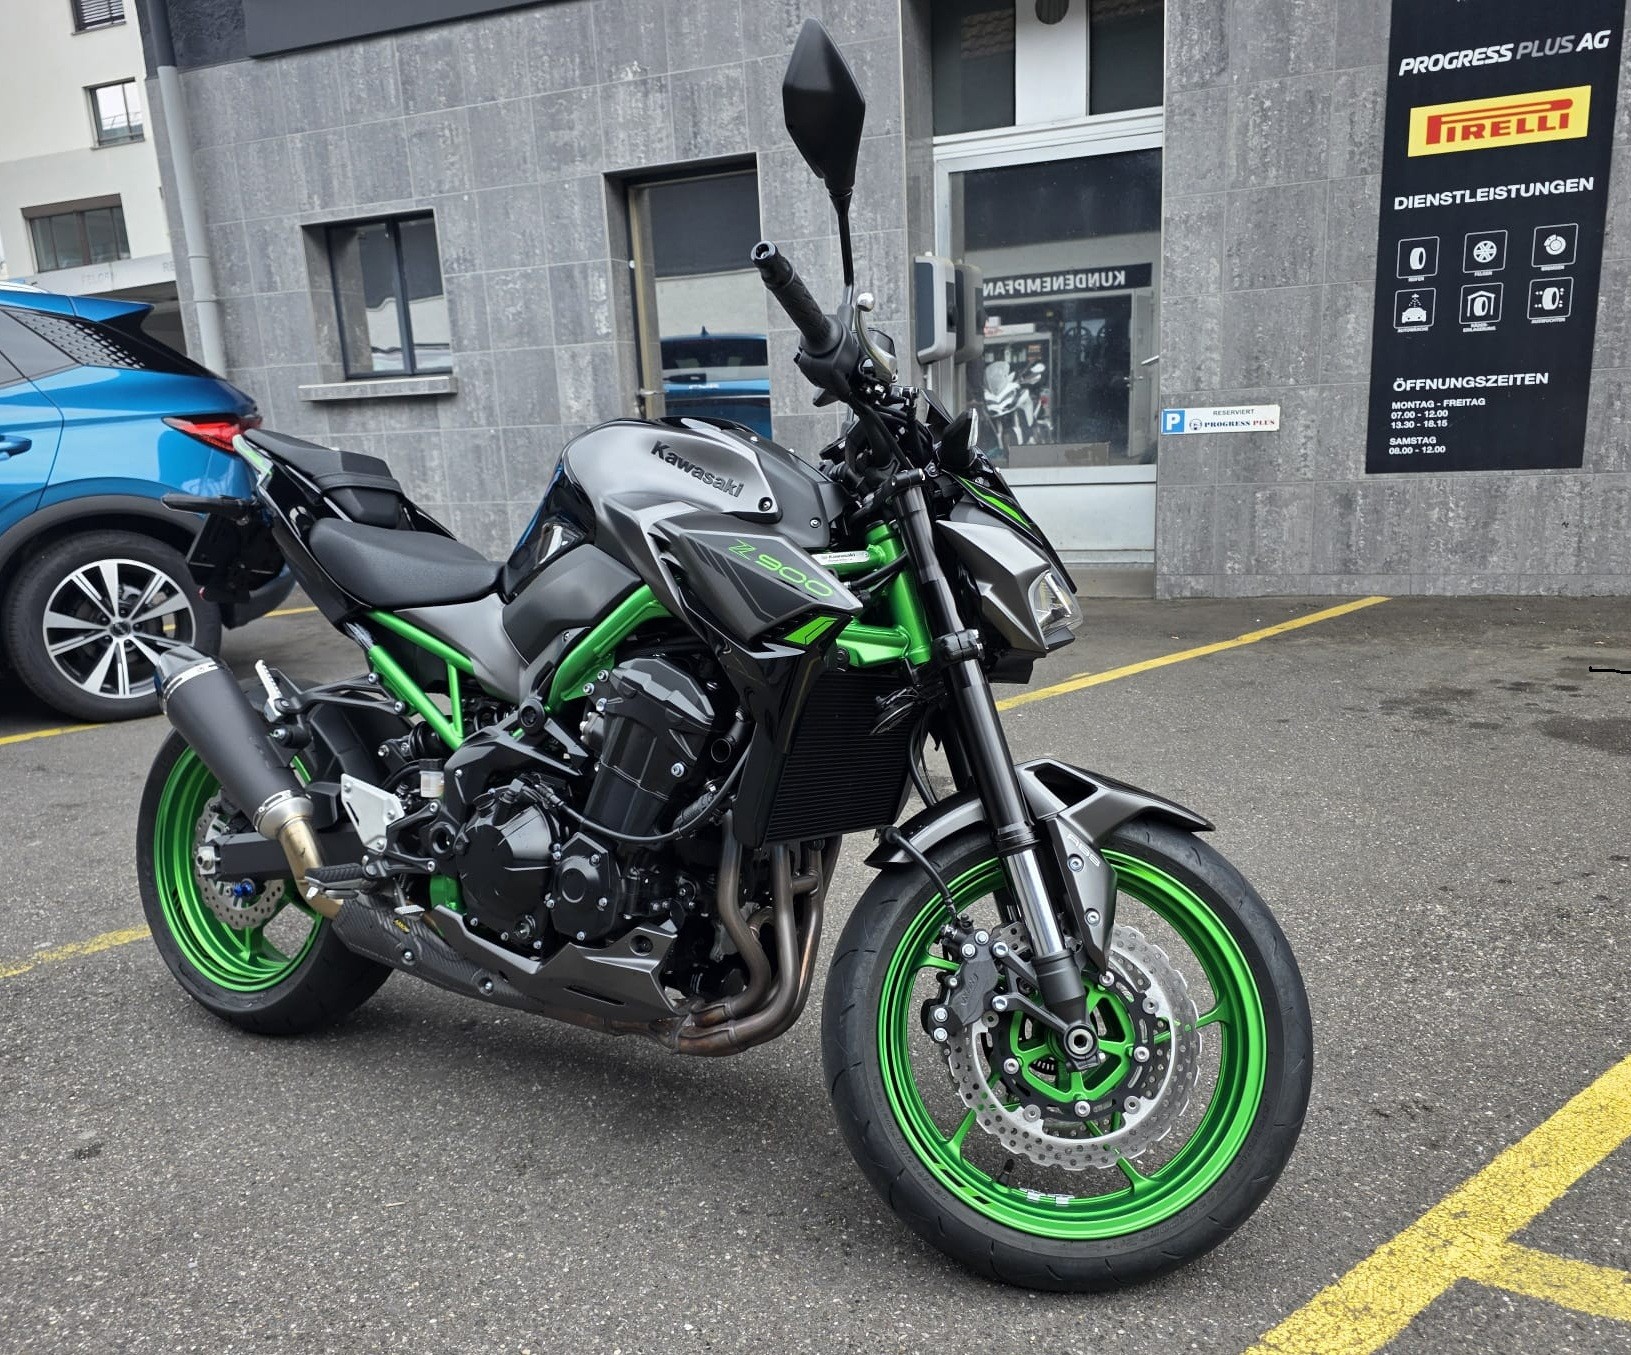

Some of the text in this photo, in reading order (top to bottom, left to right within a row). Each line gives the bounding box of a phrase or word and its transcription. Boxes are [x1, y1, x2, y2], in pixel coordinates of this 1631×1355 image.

[1399, 29, 1611, 76] PROGRESS PLUS AG
[1426, 98, 1573, 145] PIRELLI
[1394, 176, 1594, 210] DIENSTLEISTUNGEN
[1393, 372, 1549, 392] ÖFFNUNGSZEITEN
[1391, 400, 1435, 410] MONTAG
[1443, 398, 1486, 407] FREITAG
[1212, 408, 1255, 416] RESERVIERT
[1390, 411, 1416, 420] 07.00
[1424, 409, 1449, 418] 12.00
[1166, 413, 1181, 431] P
[1204, 420, 1251, 428] PROGRESS
[1391, 421, 1415, 429] 13.30
[1423, 419, 1448, 428] 18.15
[1389, 436, 1437, 445] SAMSTAG
[1388, 446, 1413, 455] 08.00
[1421, 445, 1446, 454] 12.00
[650, 440, 745, 498] Kawasaki
